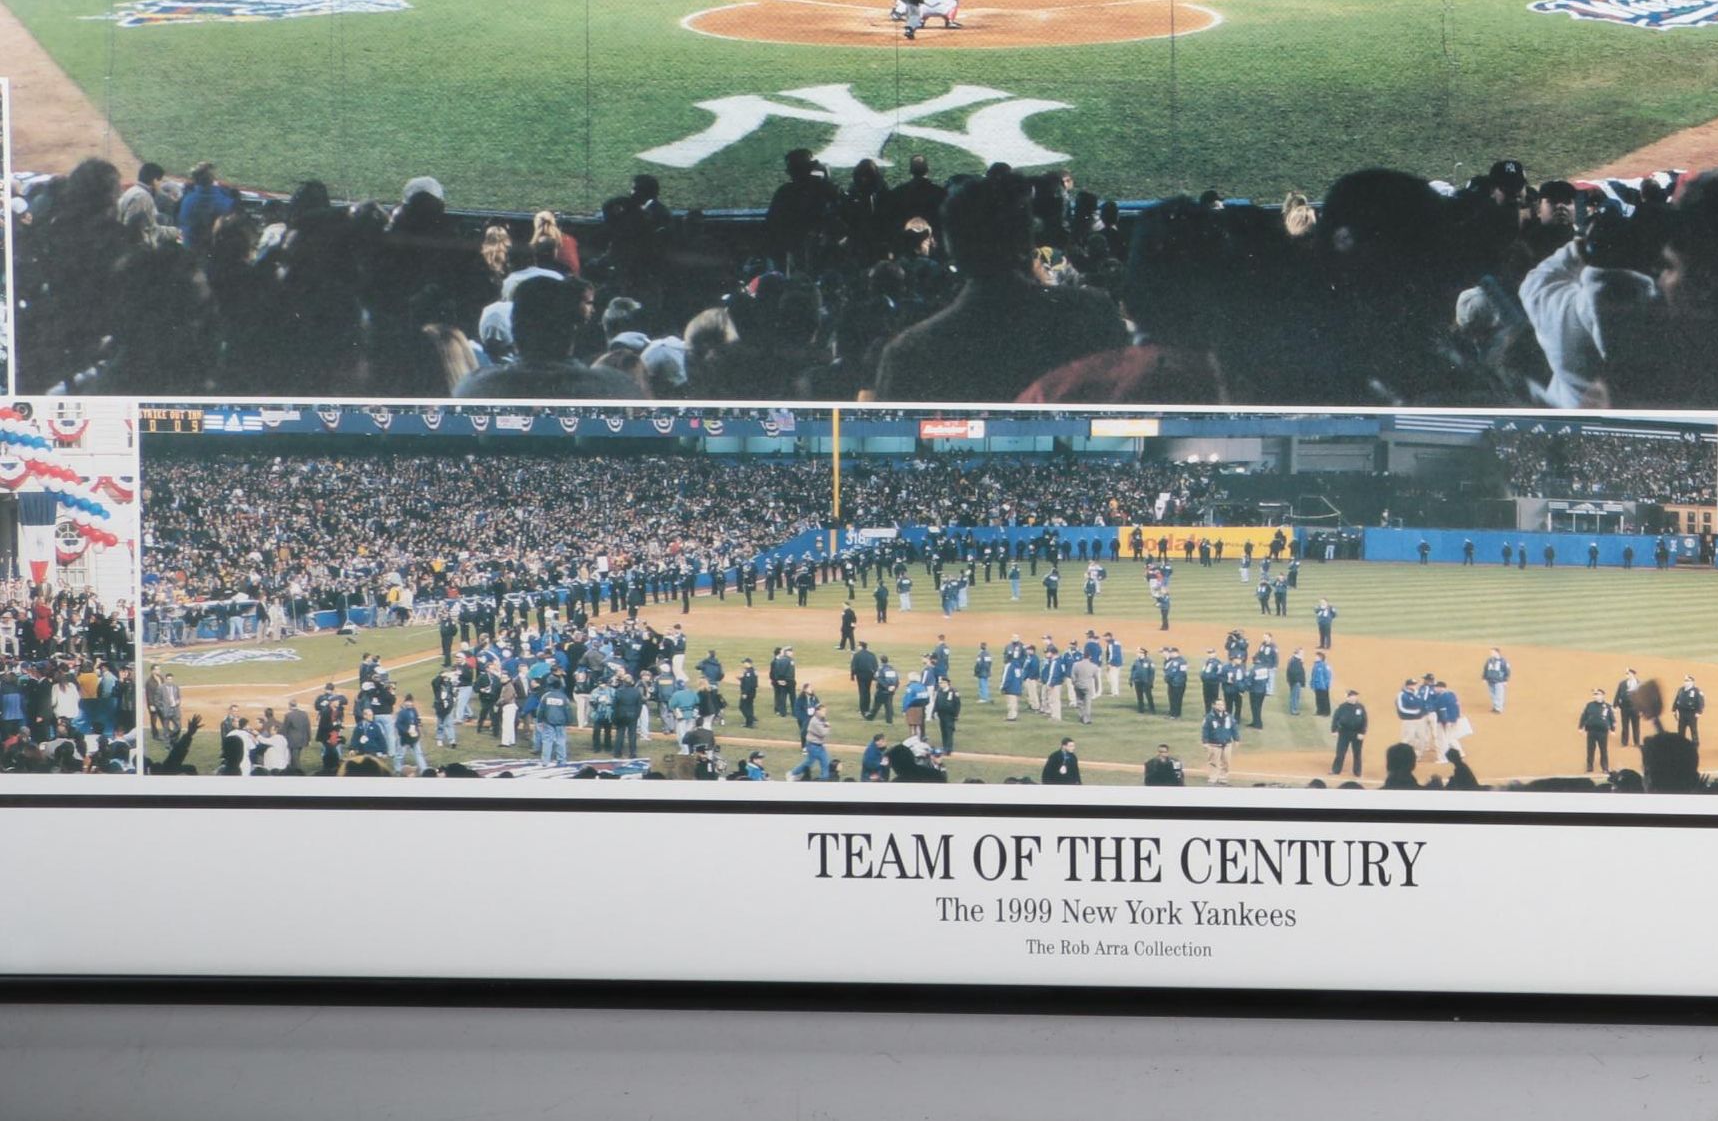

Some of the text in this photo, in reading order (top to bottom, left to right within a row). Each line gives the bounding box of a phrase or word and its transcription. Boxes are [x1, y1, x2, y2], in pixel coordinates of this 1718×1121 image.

[807, 832, 1428, 888] TEAM OF THE CENTURY
[935, 897, 1297, 927] The 1999 New York Yankees
[1026, 939, 1213, 958] The Rob Arra Collection
